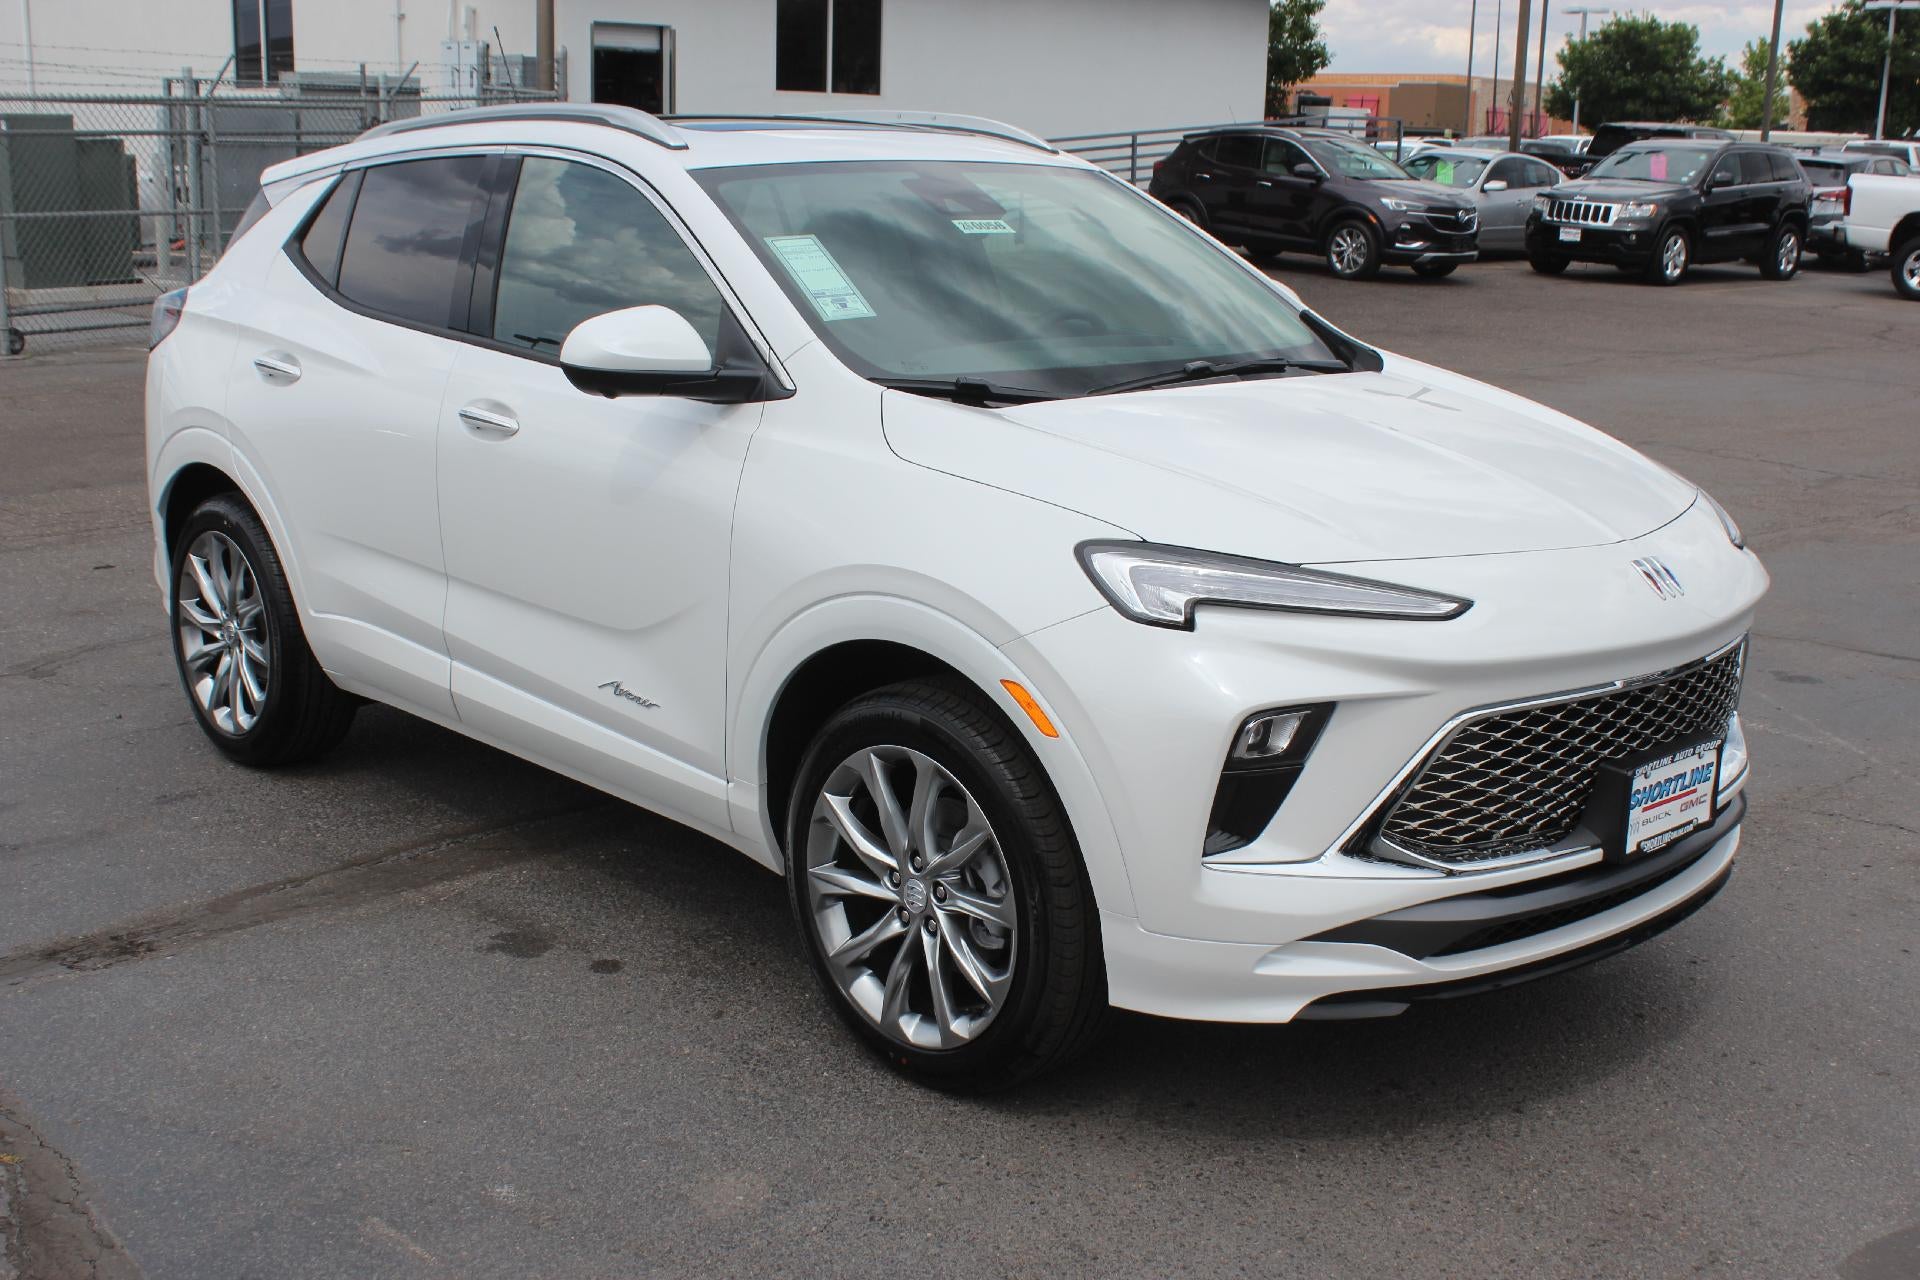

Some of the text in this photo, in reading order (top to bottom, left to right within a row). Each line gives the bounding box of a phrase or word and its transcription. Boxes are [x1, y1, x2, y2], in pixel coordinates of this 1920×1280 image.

[1635, 739, 1721, 777] SHORTLINE AUTO GROUP
[1629, 762, 1714, 810] SHORTLINE
[1641, 793, 1707, 826] BUICK GMC
